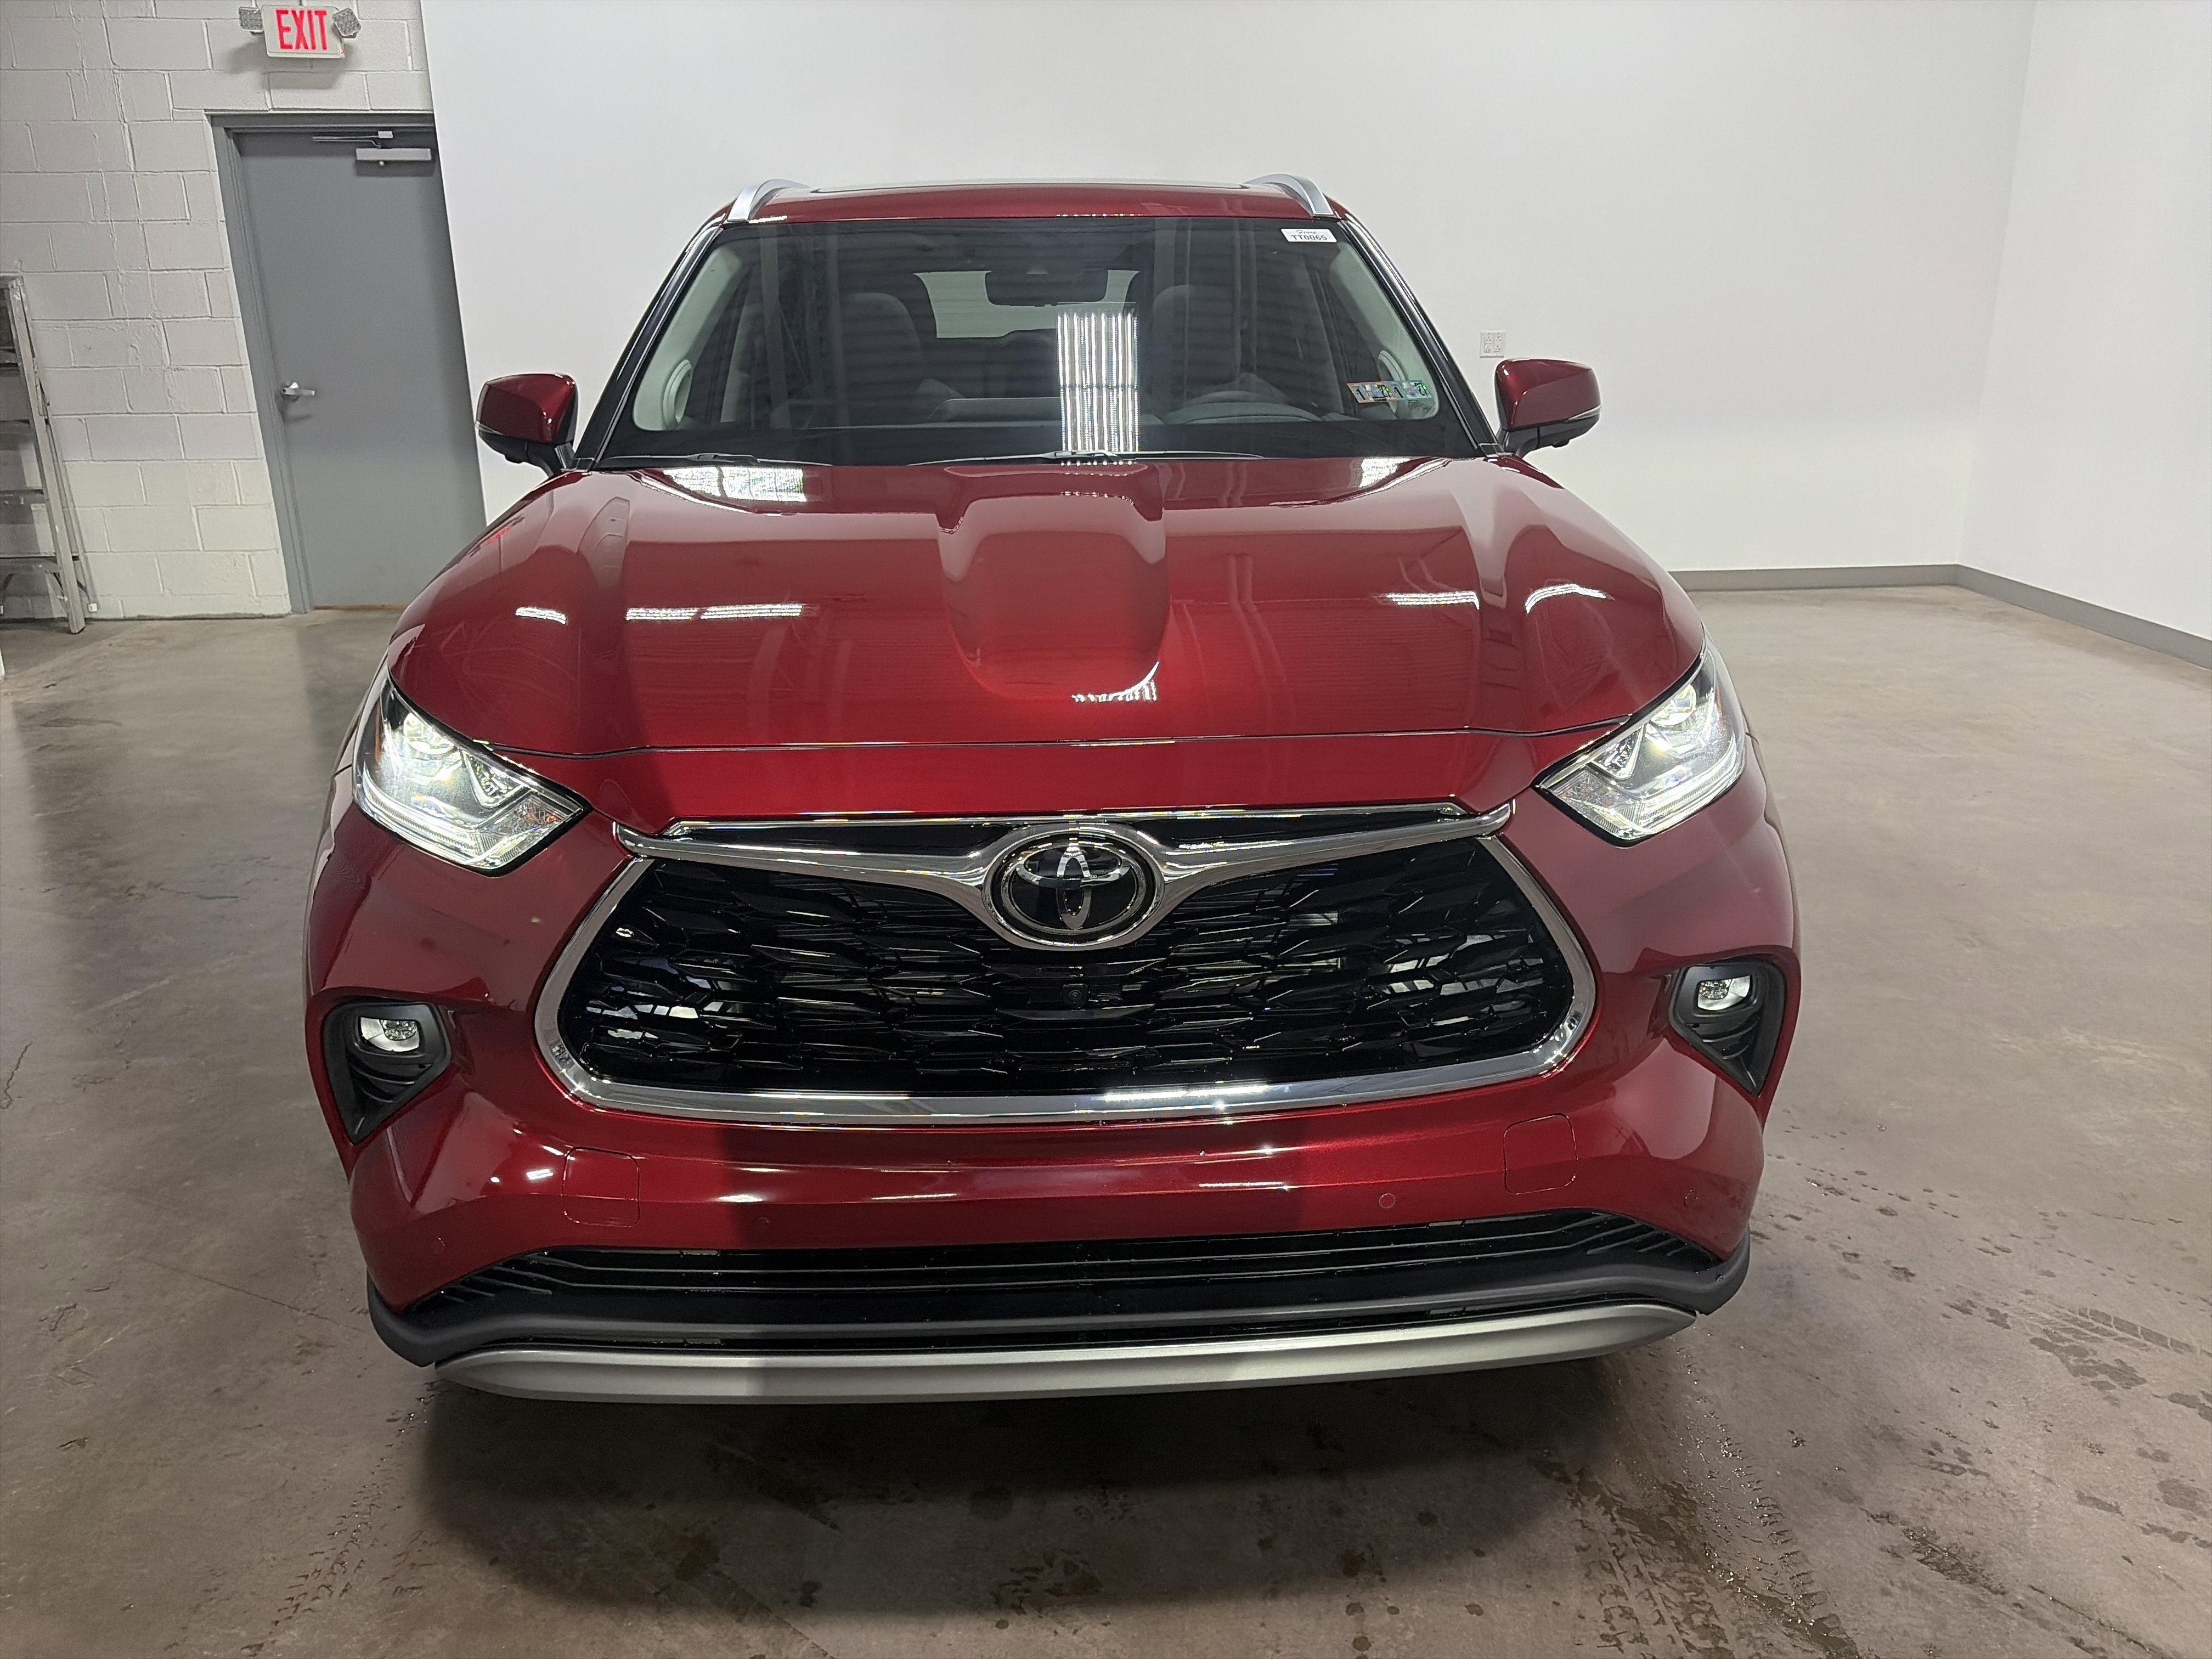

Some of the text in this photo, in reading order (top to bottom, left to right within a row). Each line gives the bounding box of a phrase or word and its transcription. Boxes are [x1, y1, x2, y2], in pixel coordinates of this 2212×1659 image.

[275, 9, 327, 50] EXIT
[1356, 388, 1366, 400] 1
[1394, 386, 1404, 398] 1
